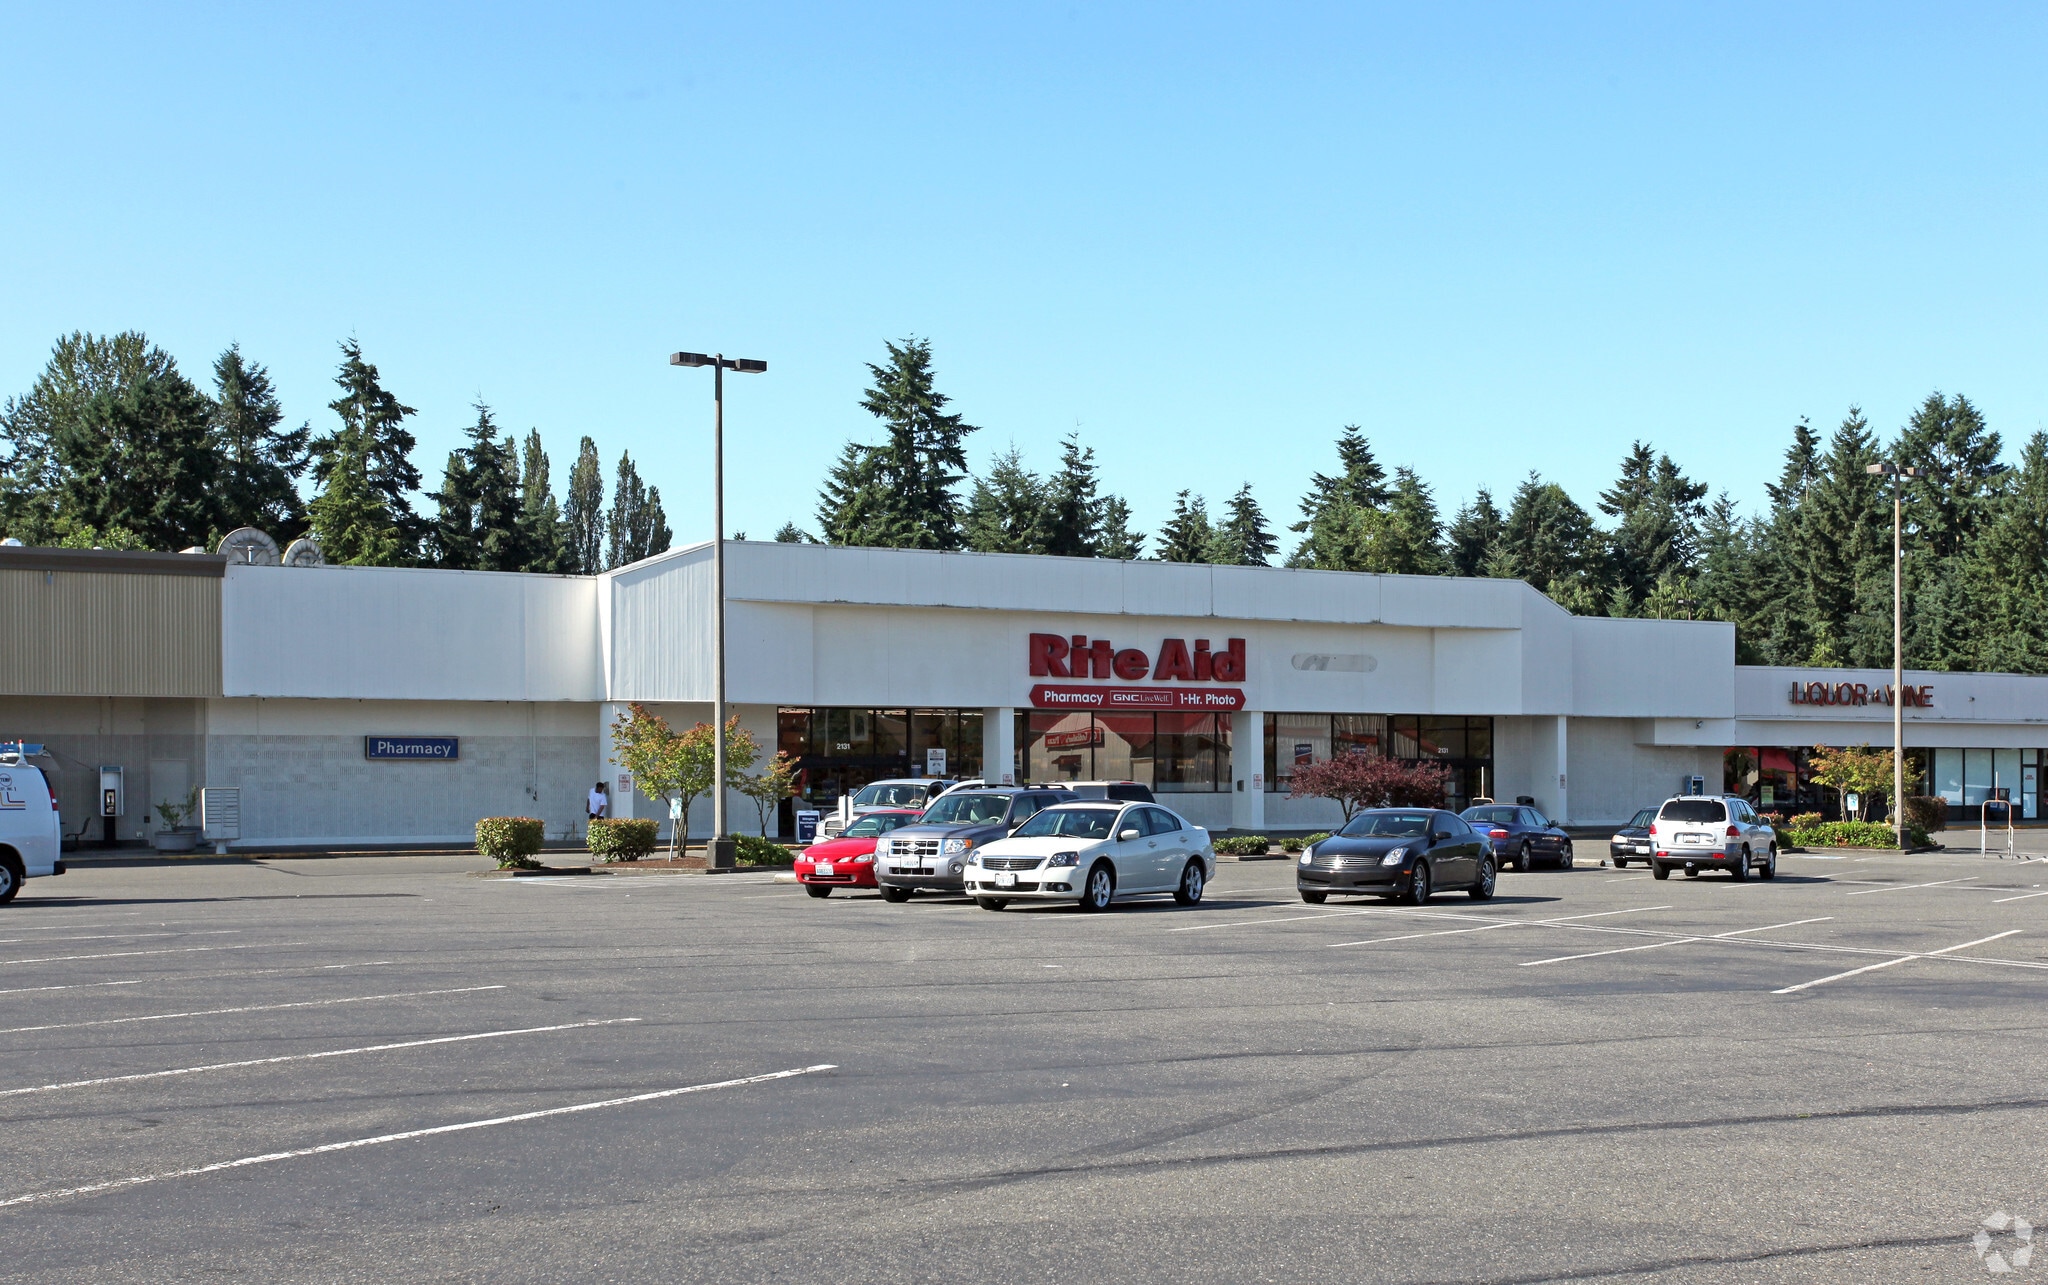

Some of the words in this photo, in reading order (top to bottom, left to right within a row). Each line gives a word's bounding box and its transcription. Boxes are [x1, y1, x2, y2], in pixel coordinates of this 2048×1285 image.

[1029, 633, 1149, 680] Rite
[1152, 638, 1246, 682] Aid
[1044, 690, 1104, 705] Pharmacy
[1113, 694, 1140, 702] GNC
[1179, 693, 1203, 705] 1-Hr.
[1205, 693, 1236, 705] Photo
[1792, 681, 1868, 706] LIQUOR
[1885, 684, 1934, 707] WINE
[377, 741, 451, 757] Pharmacy
[836, 742, 850, 750] 2131
